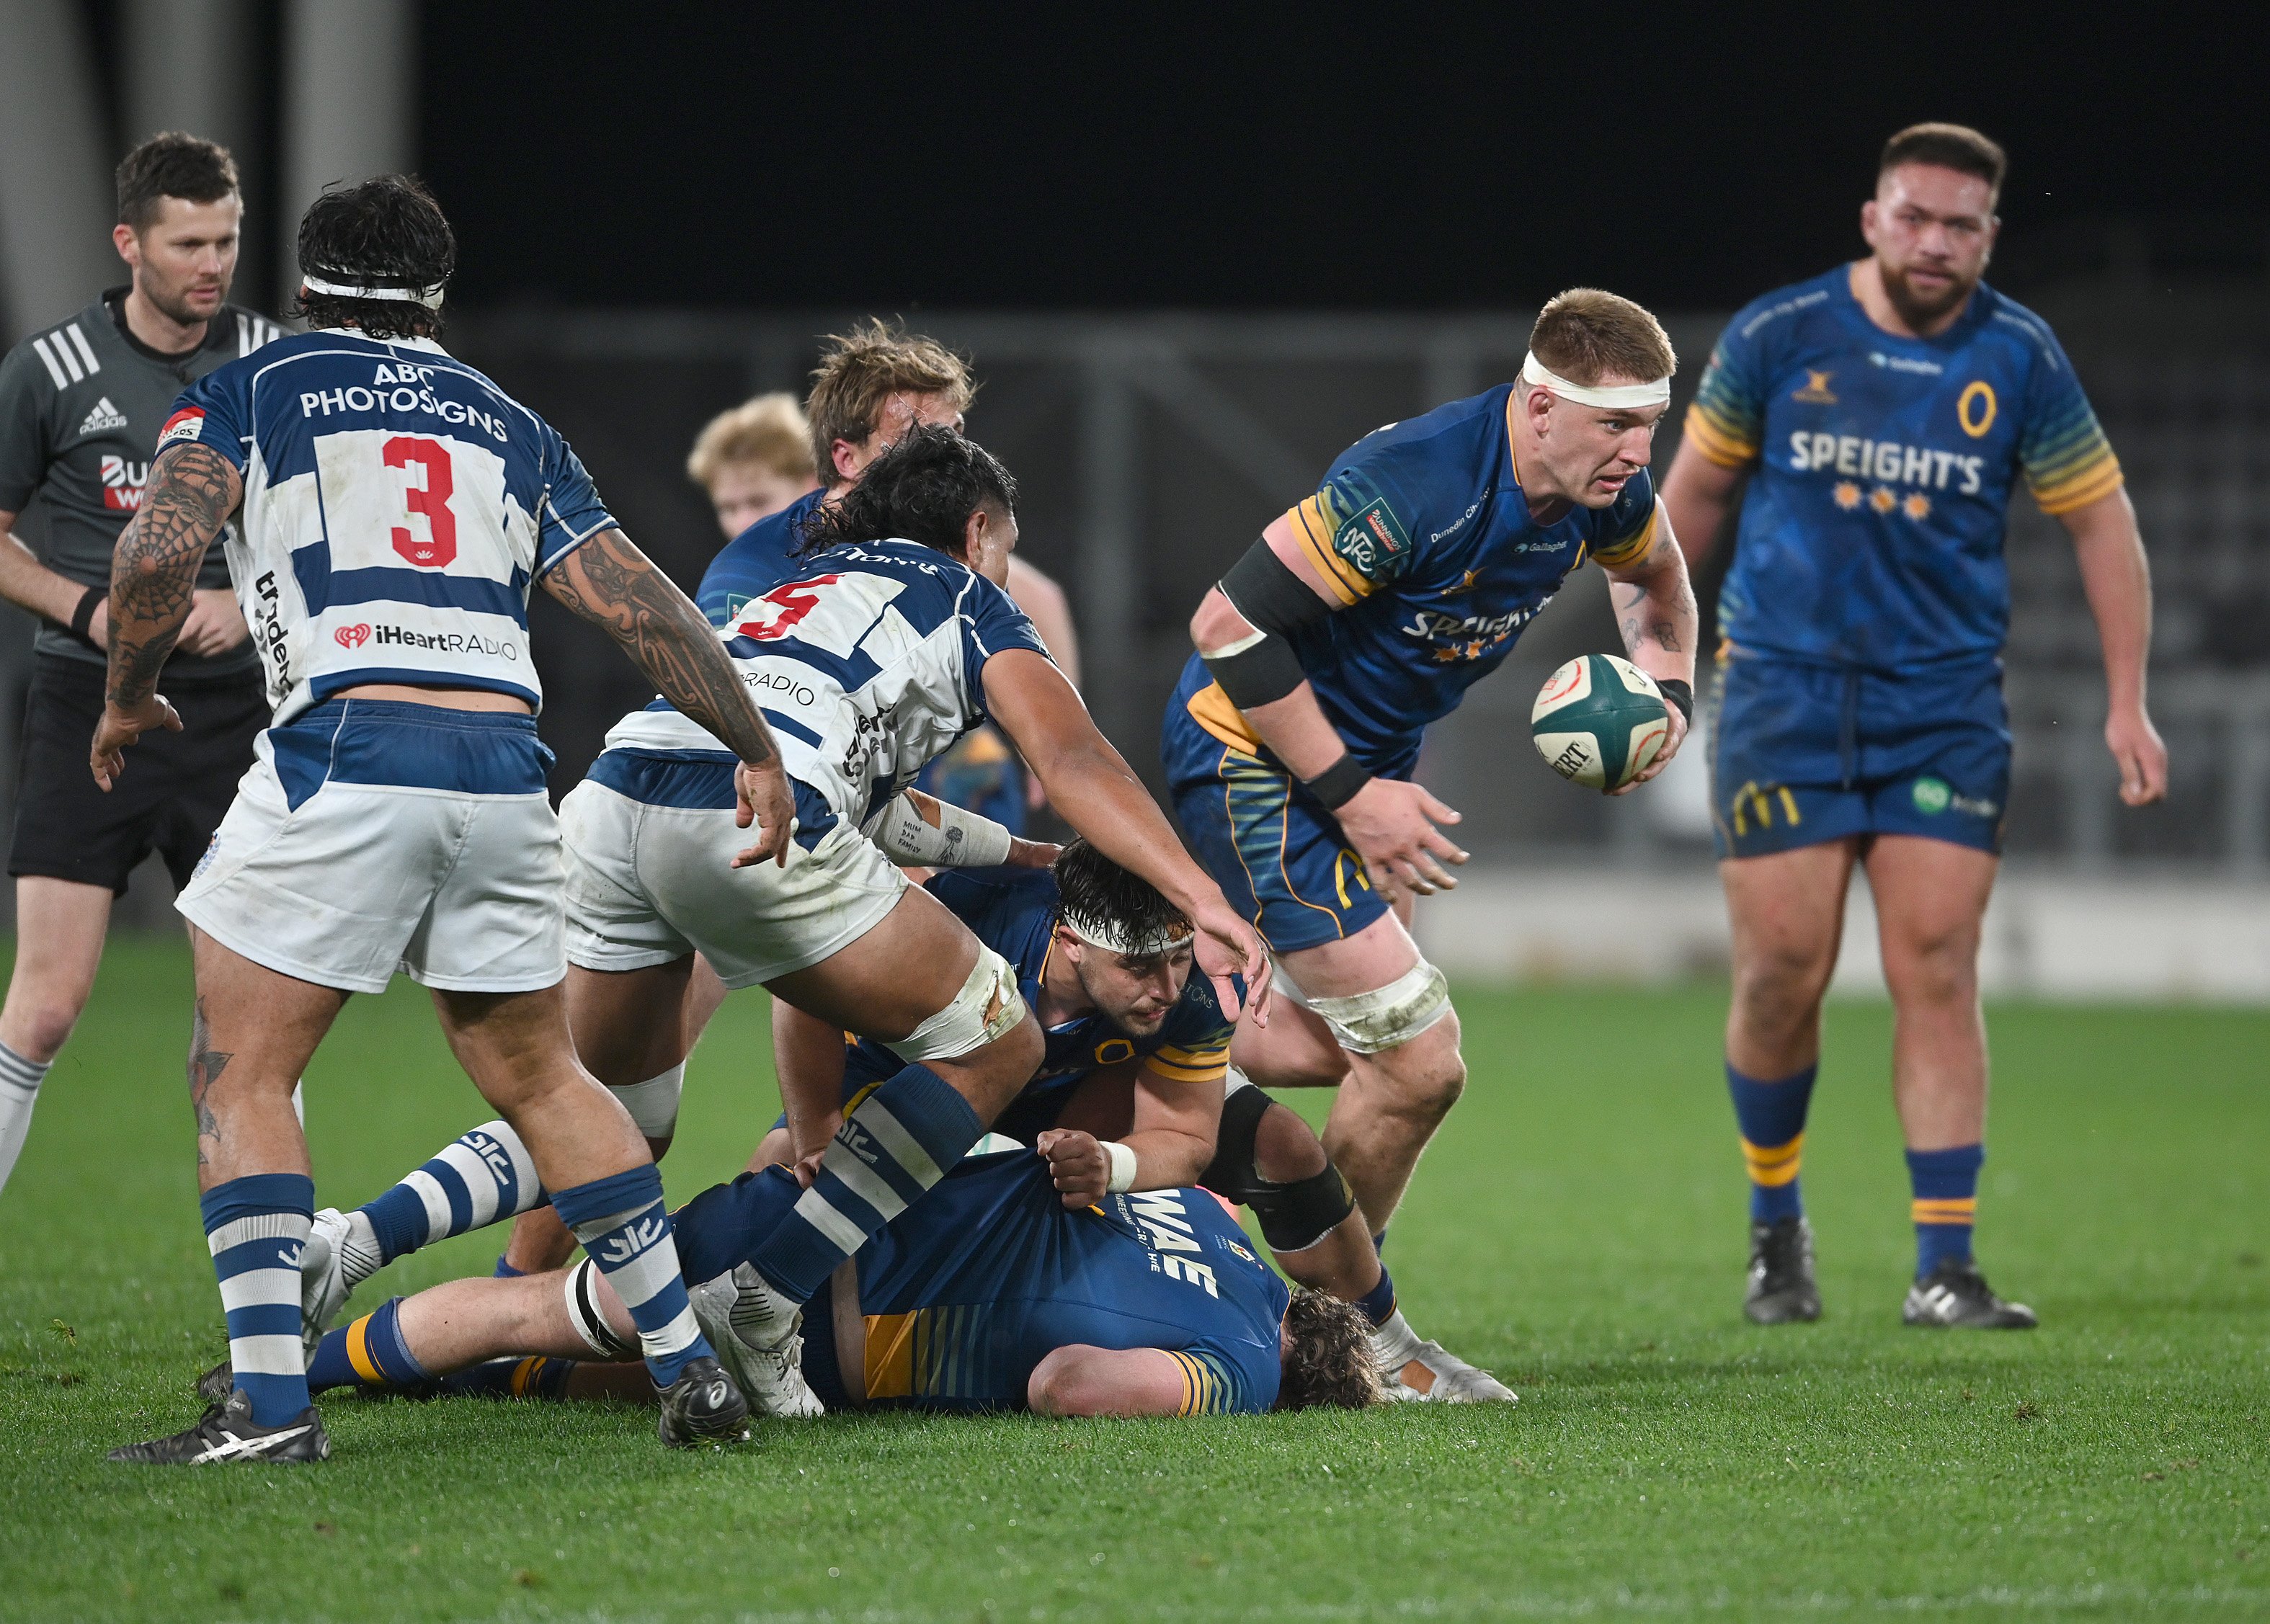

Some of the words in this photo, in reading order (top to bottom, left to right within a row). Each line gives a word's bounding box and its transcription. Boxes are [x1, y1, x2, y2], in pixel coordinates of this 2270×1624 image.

[373, 364, 435, 391] ABC
[79, 415, 128, 436] adidas
[300, 386, 508, 442] PHOTOSIGNS
[1789, 431, 1985, 495] SPEIGHT'S
[383, 436, 458, 568] 3
[1371, 509, 1402, 550] BUNNINGS
[1430, 517, 1465, 543] Dunedin
[737, 574, 847, 640] 5
[375, 624, 517, 661] iHeartRADIO
[739, 672, 815, 706] RADIO
[901, 829, 915, 840] DAD
[903, 821, 922, 833] MUM
[897, 838, 921, 854] FAMILY
[1185, 982, 1215, 1009] TONS
